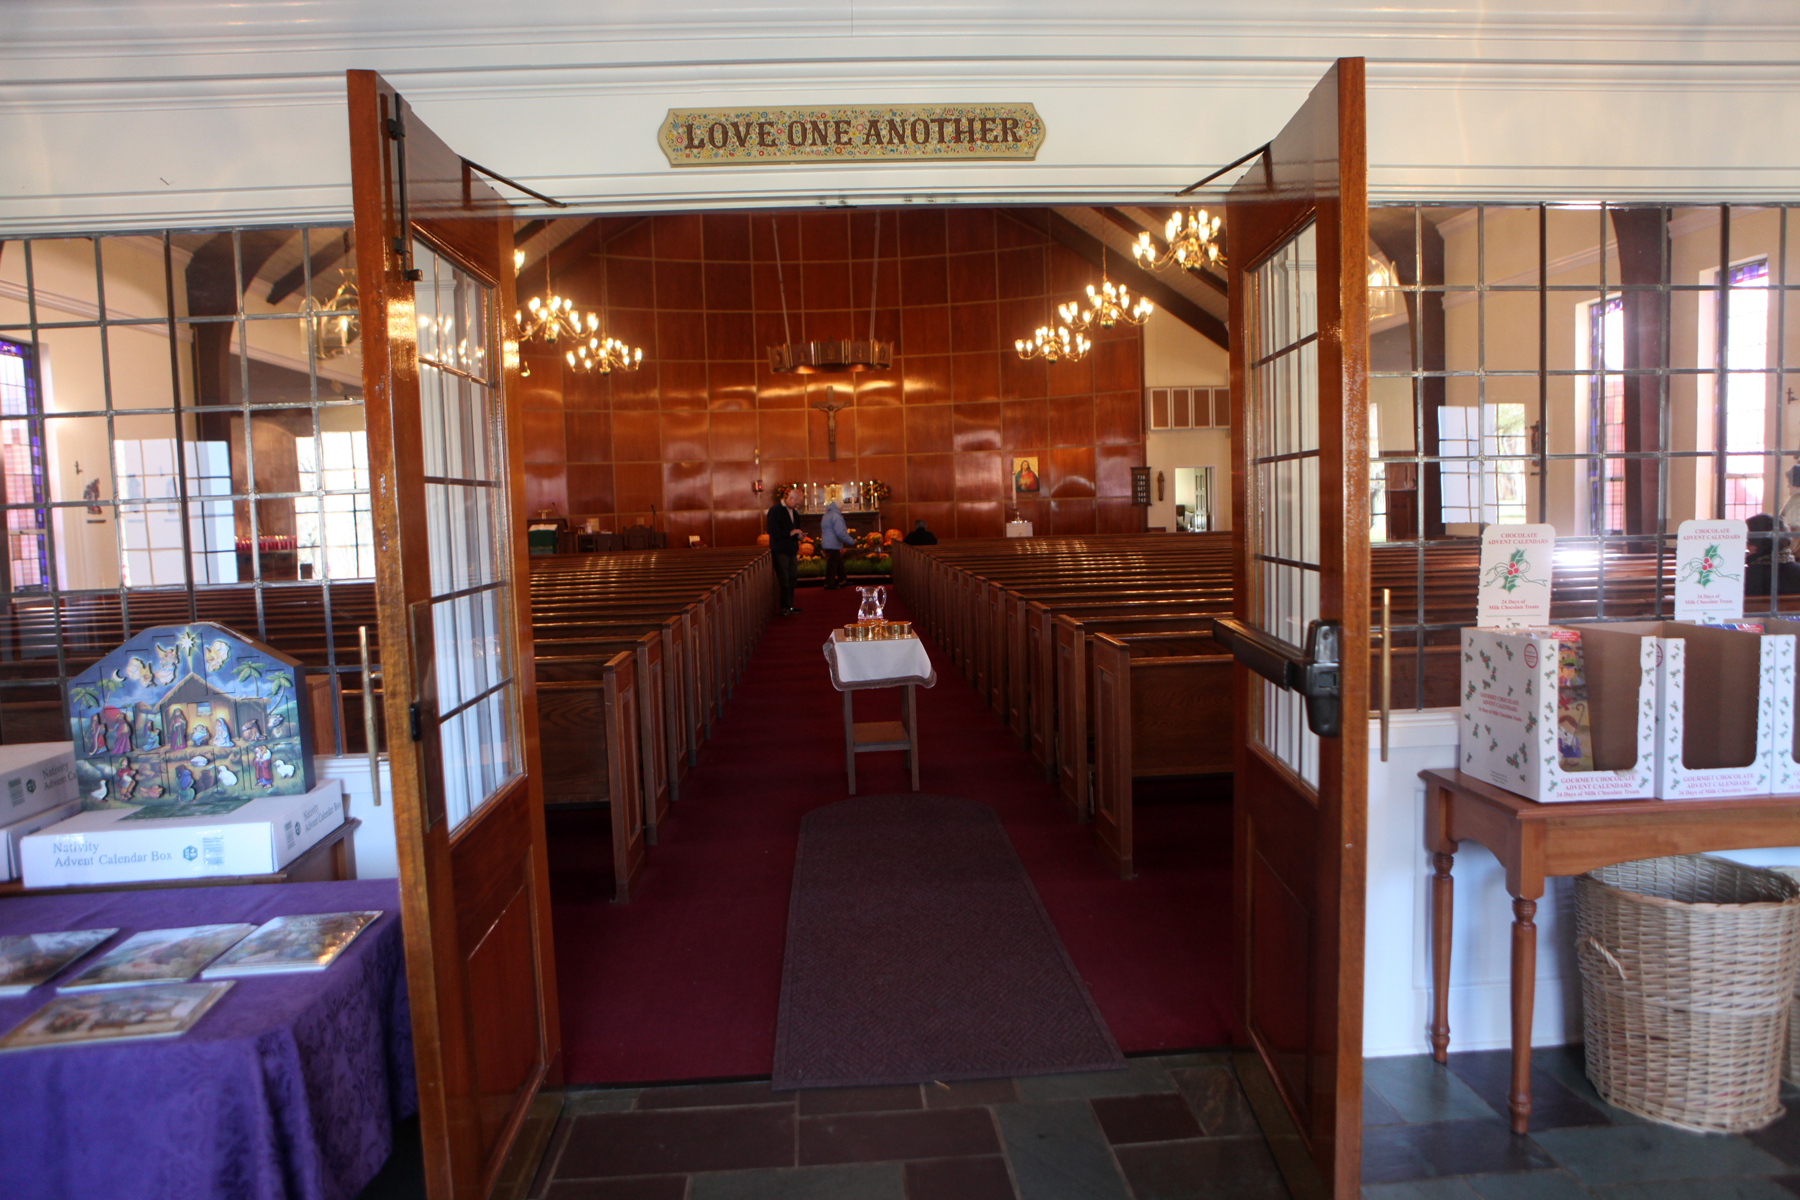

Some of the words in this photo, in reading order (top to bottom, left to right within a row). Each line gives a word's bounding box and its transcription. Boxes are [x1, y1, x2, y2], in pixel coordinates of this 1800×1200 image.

[684, 121, 779, 149] LOVE
[787, 119, 853, 146] ONE
[862, 117, 1022, 146] ANOTHER
[42, 762, 69, 779] Nativity
[44, 775, 67, 791] Advent
[53, 842, 100, 854] Nativity
[54, 856, 94, 867] Advent
[98, 851, 148, 865] Calendar
[151, 850, 173, 862] Box
